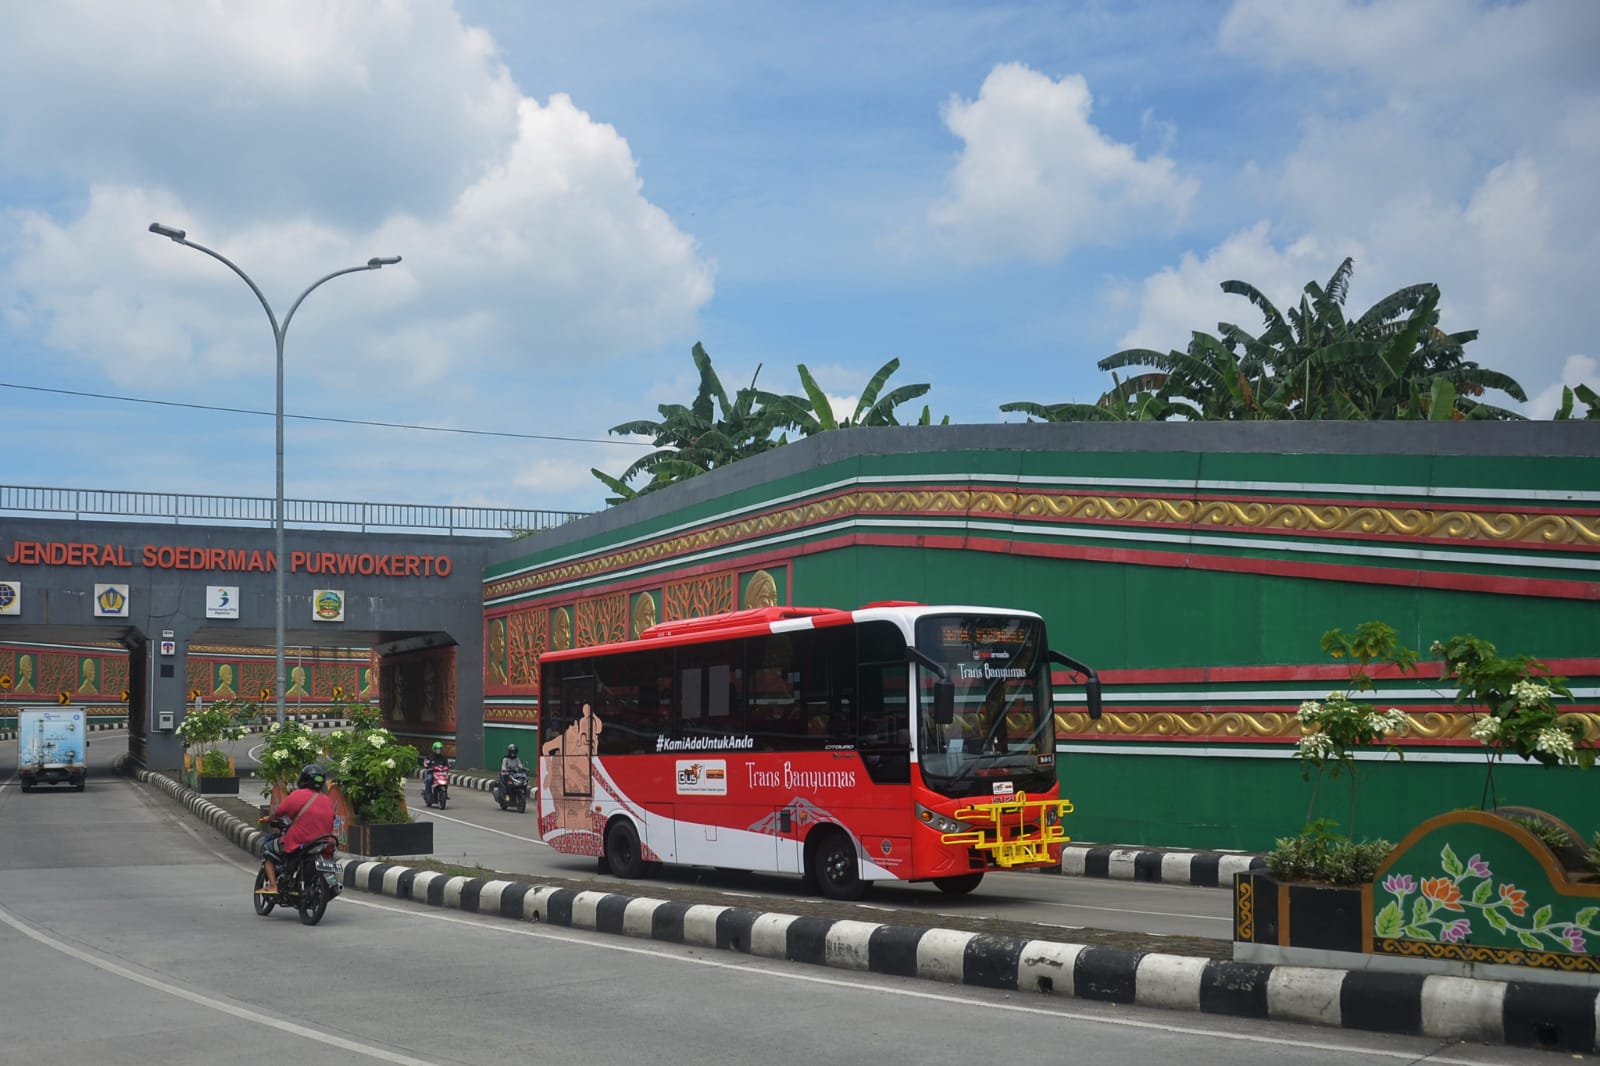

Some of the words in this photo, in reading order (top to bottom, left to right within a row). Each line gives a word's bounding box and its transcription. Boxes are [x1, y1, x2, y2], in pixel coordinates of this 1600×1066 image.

[6, 541, 132, 566] JENDERAL
[142, 545, 277, 571] SOEDIRMAN
[291, 551, 452, 577] PURWOKERTO
[957, 663, 983, 680] Trans
[984, 662, 1026, 681] Banyumas
[656, 735, 753, 752] #KamiAdaUntukAnda
[745, 761, 780, 788] Trans
[784, 761, 855, 794] Banyumas
